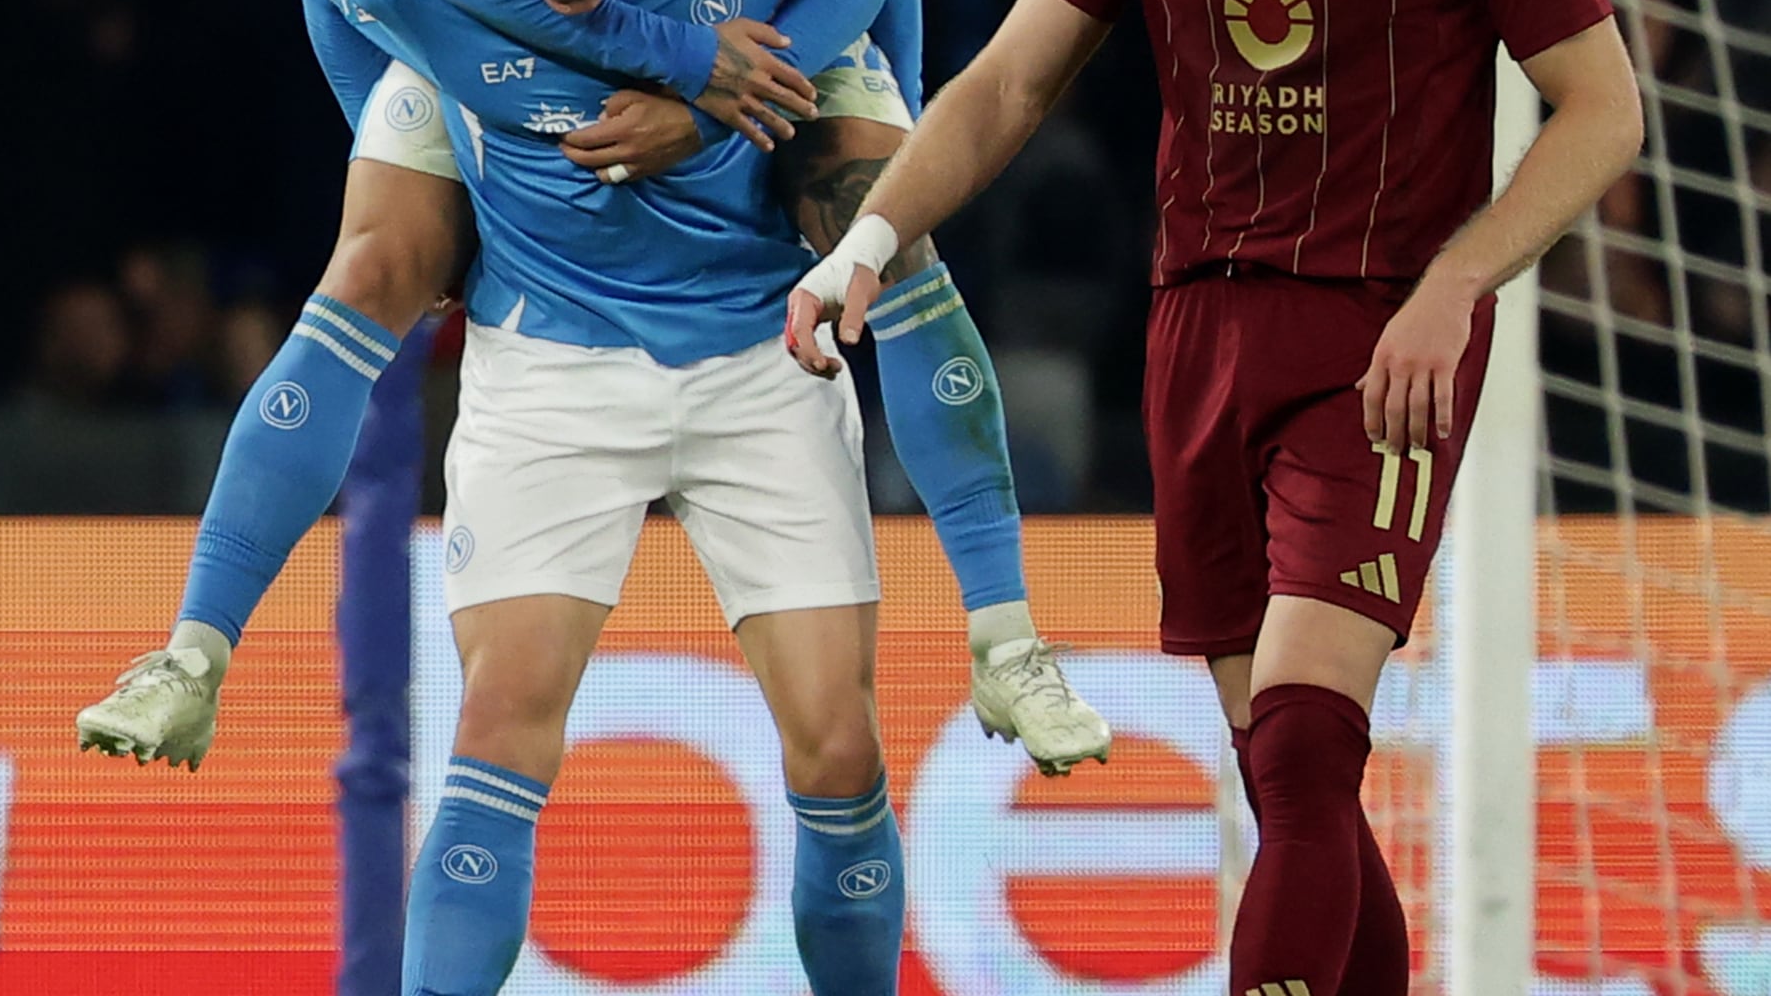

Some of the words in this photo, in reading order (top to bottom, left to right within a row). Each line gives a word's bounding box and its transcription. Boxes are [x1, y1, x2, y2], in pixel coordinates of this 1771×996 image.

[481, 57, 535, 83] EA7
[1213, 83, 1323, 108] RIYADH
[1211, 110, 1323, 135] SEASON
[1371, 440, 1432, 542] 11
